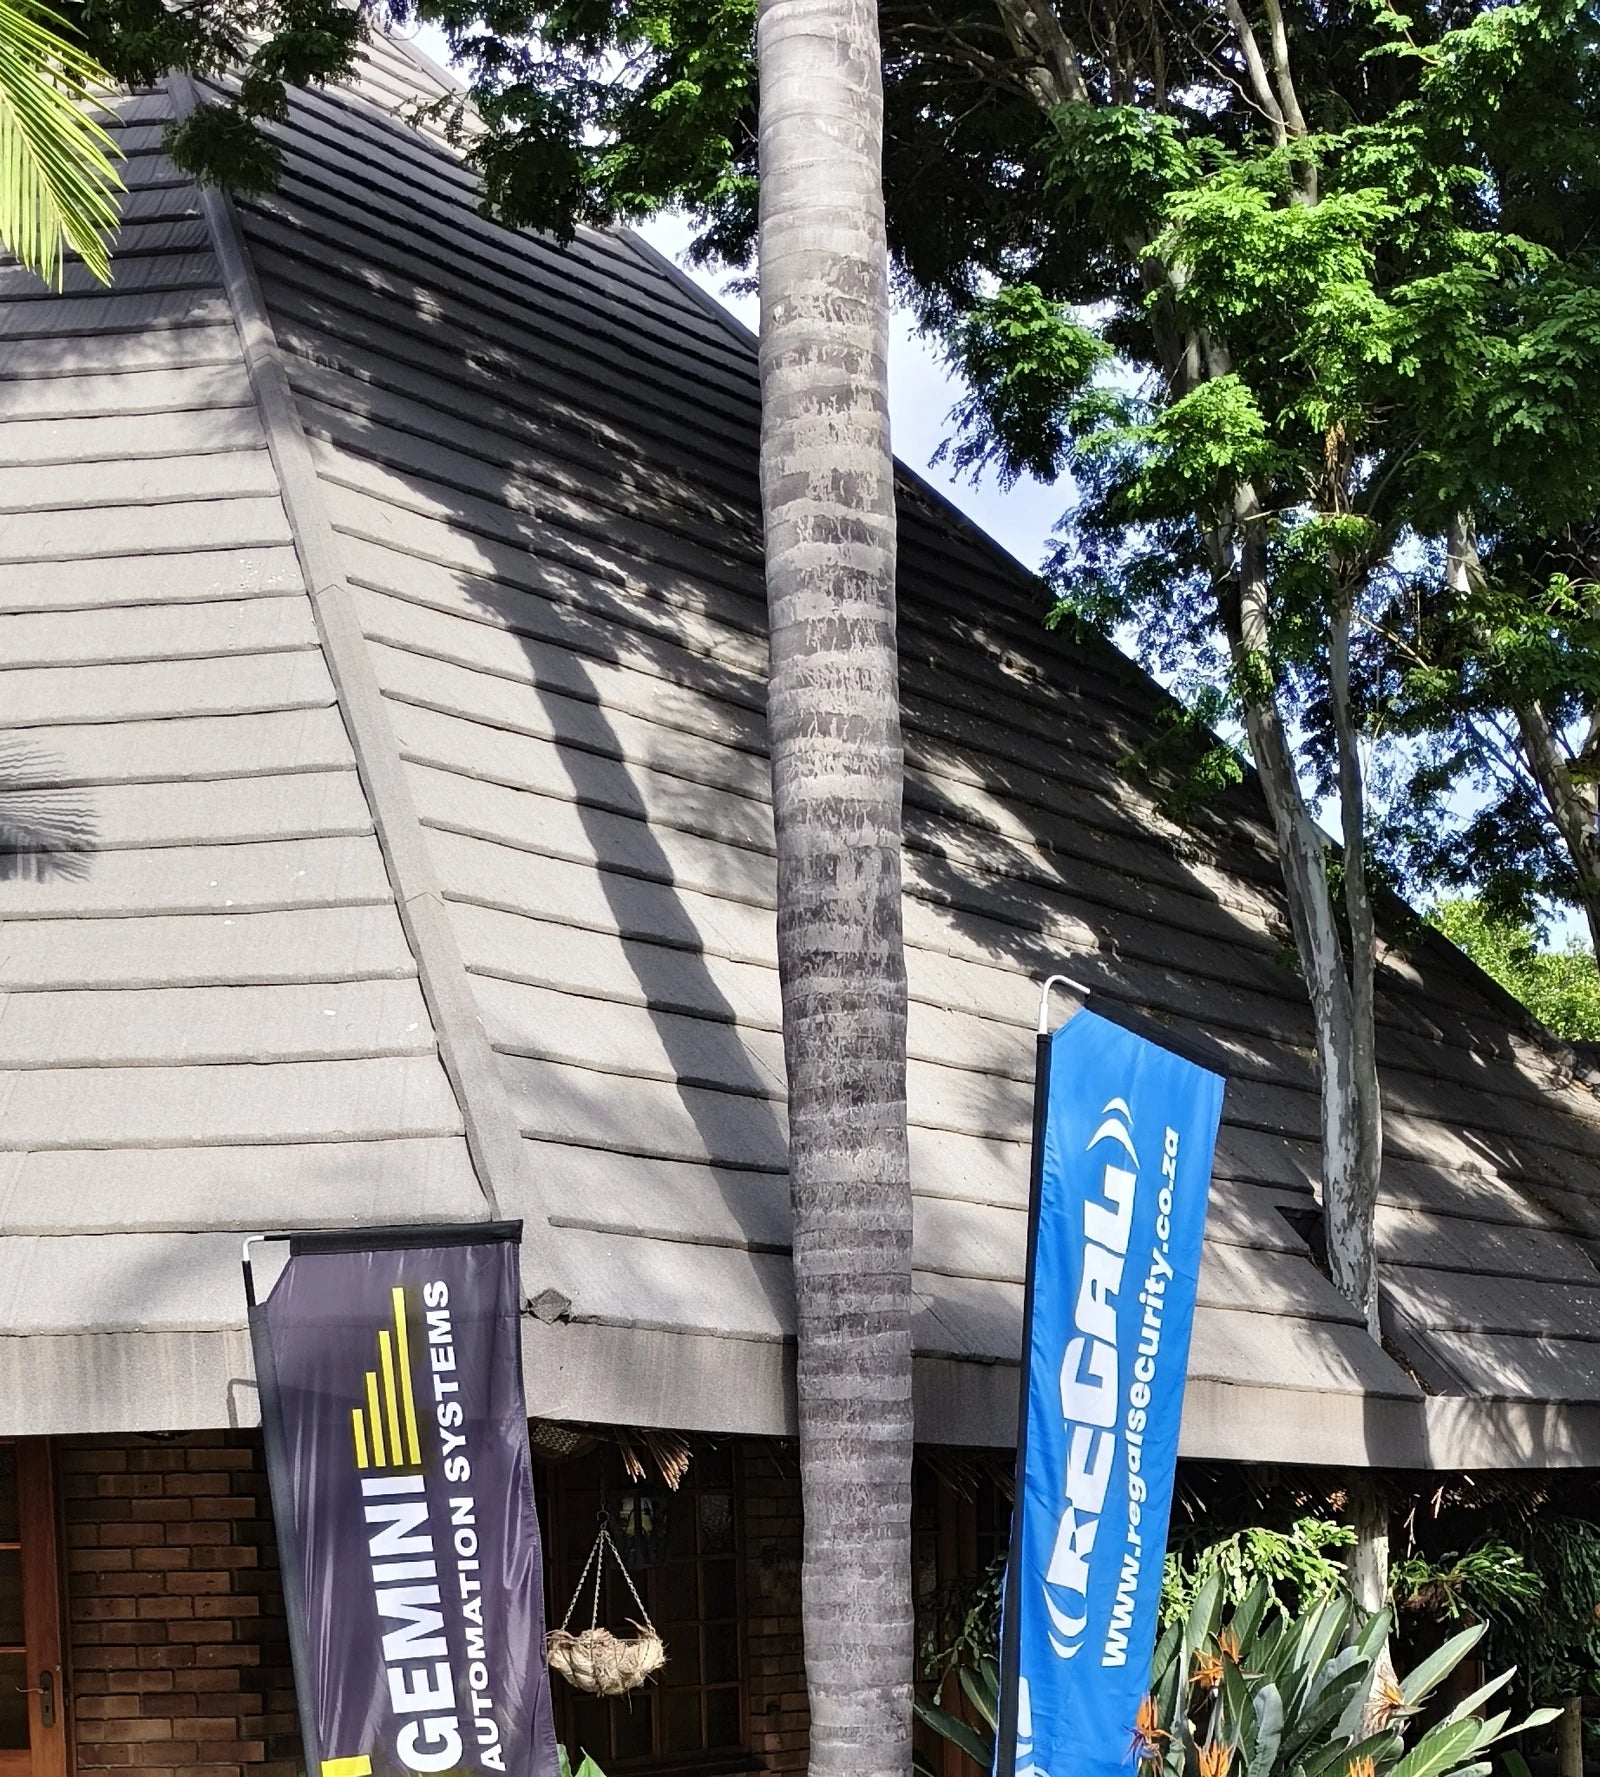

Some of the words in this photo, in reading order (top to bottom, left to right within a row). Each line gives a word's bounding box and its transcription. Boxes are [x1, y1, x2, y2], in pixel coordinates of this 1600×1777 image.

[424, 1280, 472, 1483] SYSTEMS
[1047, 1164, 1137, 1598] REGAL
[1101, 1126, 1180, 1667] www.regalsecurity.co.za
[362, 1474, 463, 1774] GEMINI
[448, 1497, 506, 1772] AUTOMATION
